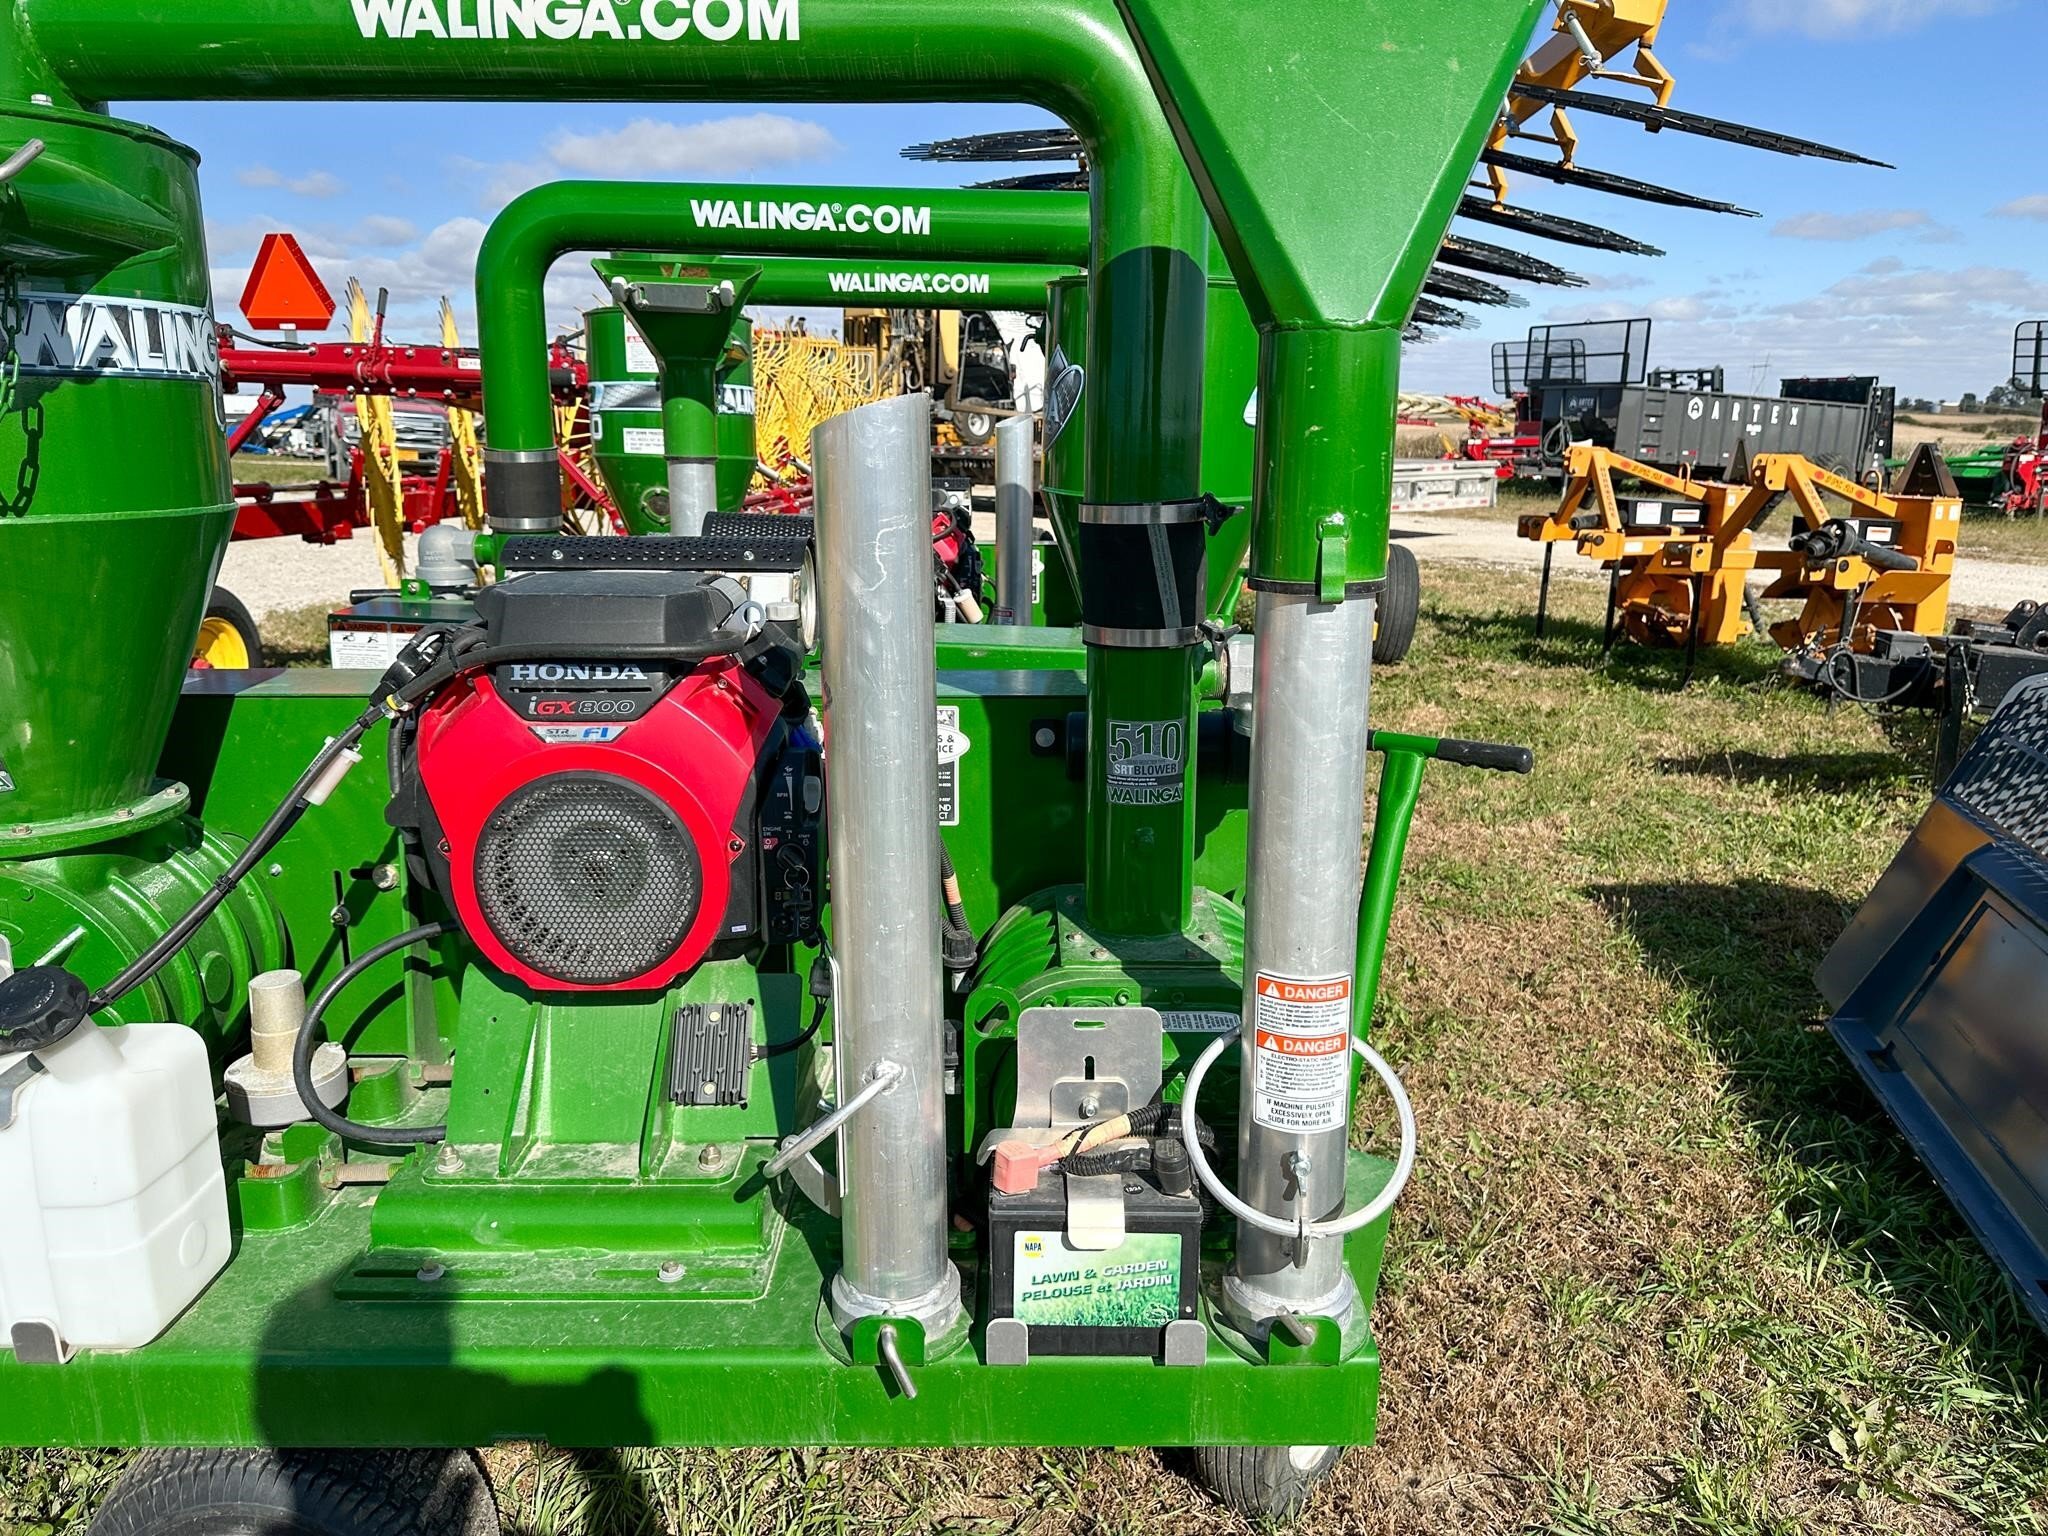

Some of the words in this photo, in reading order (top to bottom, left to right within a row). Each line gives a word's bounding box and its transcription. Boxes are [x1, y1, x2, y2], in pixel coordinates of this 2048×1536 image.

[1711, 400, 1799, 426] ARTEX
[511, 664, 648, 681] HONDA
[1108, 721, 1183, 764] 510
[1284, 984, 1344, 1000] DANGER
[1283, 1037, 1342, 1054] DANGER
[1273, 1100, 1306, 1111] MACHINE
[1305, 1100, 1335, 1111] PULSATES
[1315, 1109, 1331, 1119] OPEN
[1267, 1114, 1285, 1125] SLIDE
[1286, 1118, 1300, 1127] FOR
[1301, 1118, 1320, 1127] MORE
[1321, 1117, 1332, 1125] AIR
[1024, 1242, 1042, 1251] NAPA
[1031, 1270, 1080, 1286] LAWN
[1084, 1268, 1097, 1279] &
[1102, 1259, 1169, 1277] GARDEN
[1021, 1284, 1093, 1302] PELOUSE
[1096, 1282, 1113, 1294] et
[1116, 1274, 1174, 1291] JARDIN
